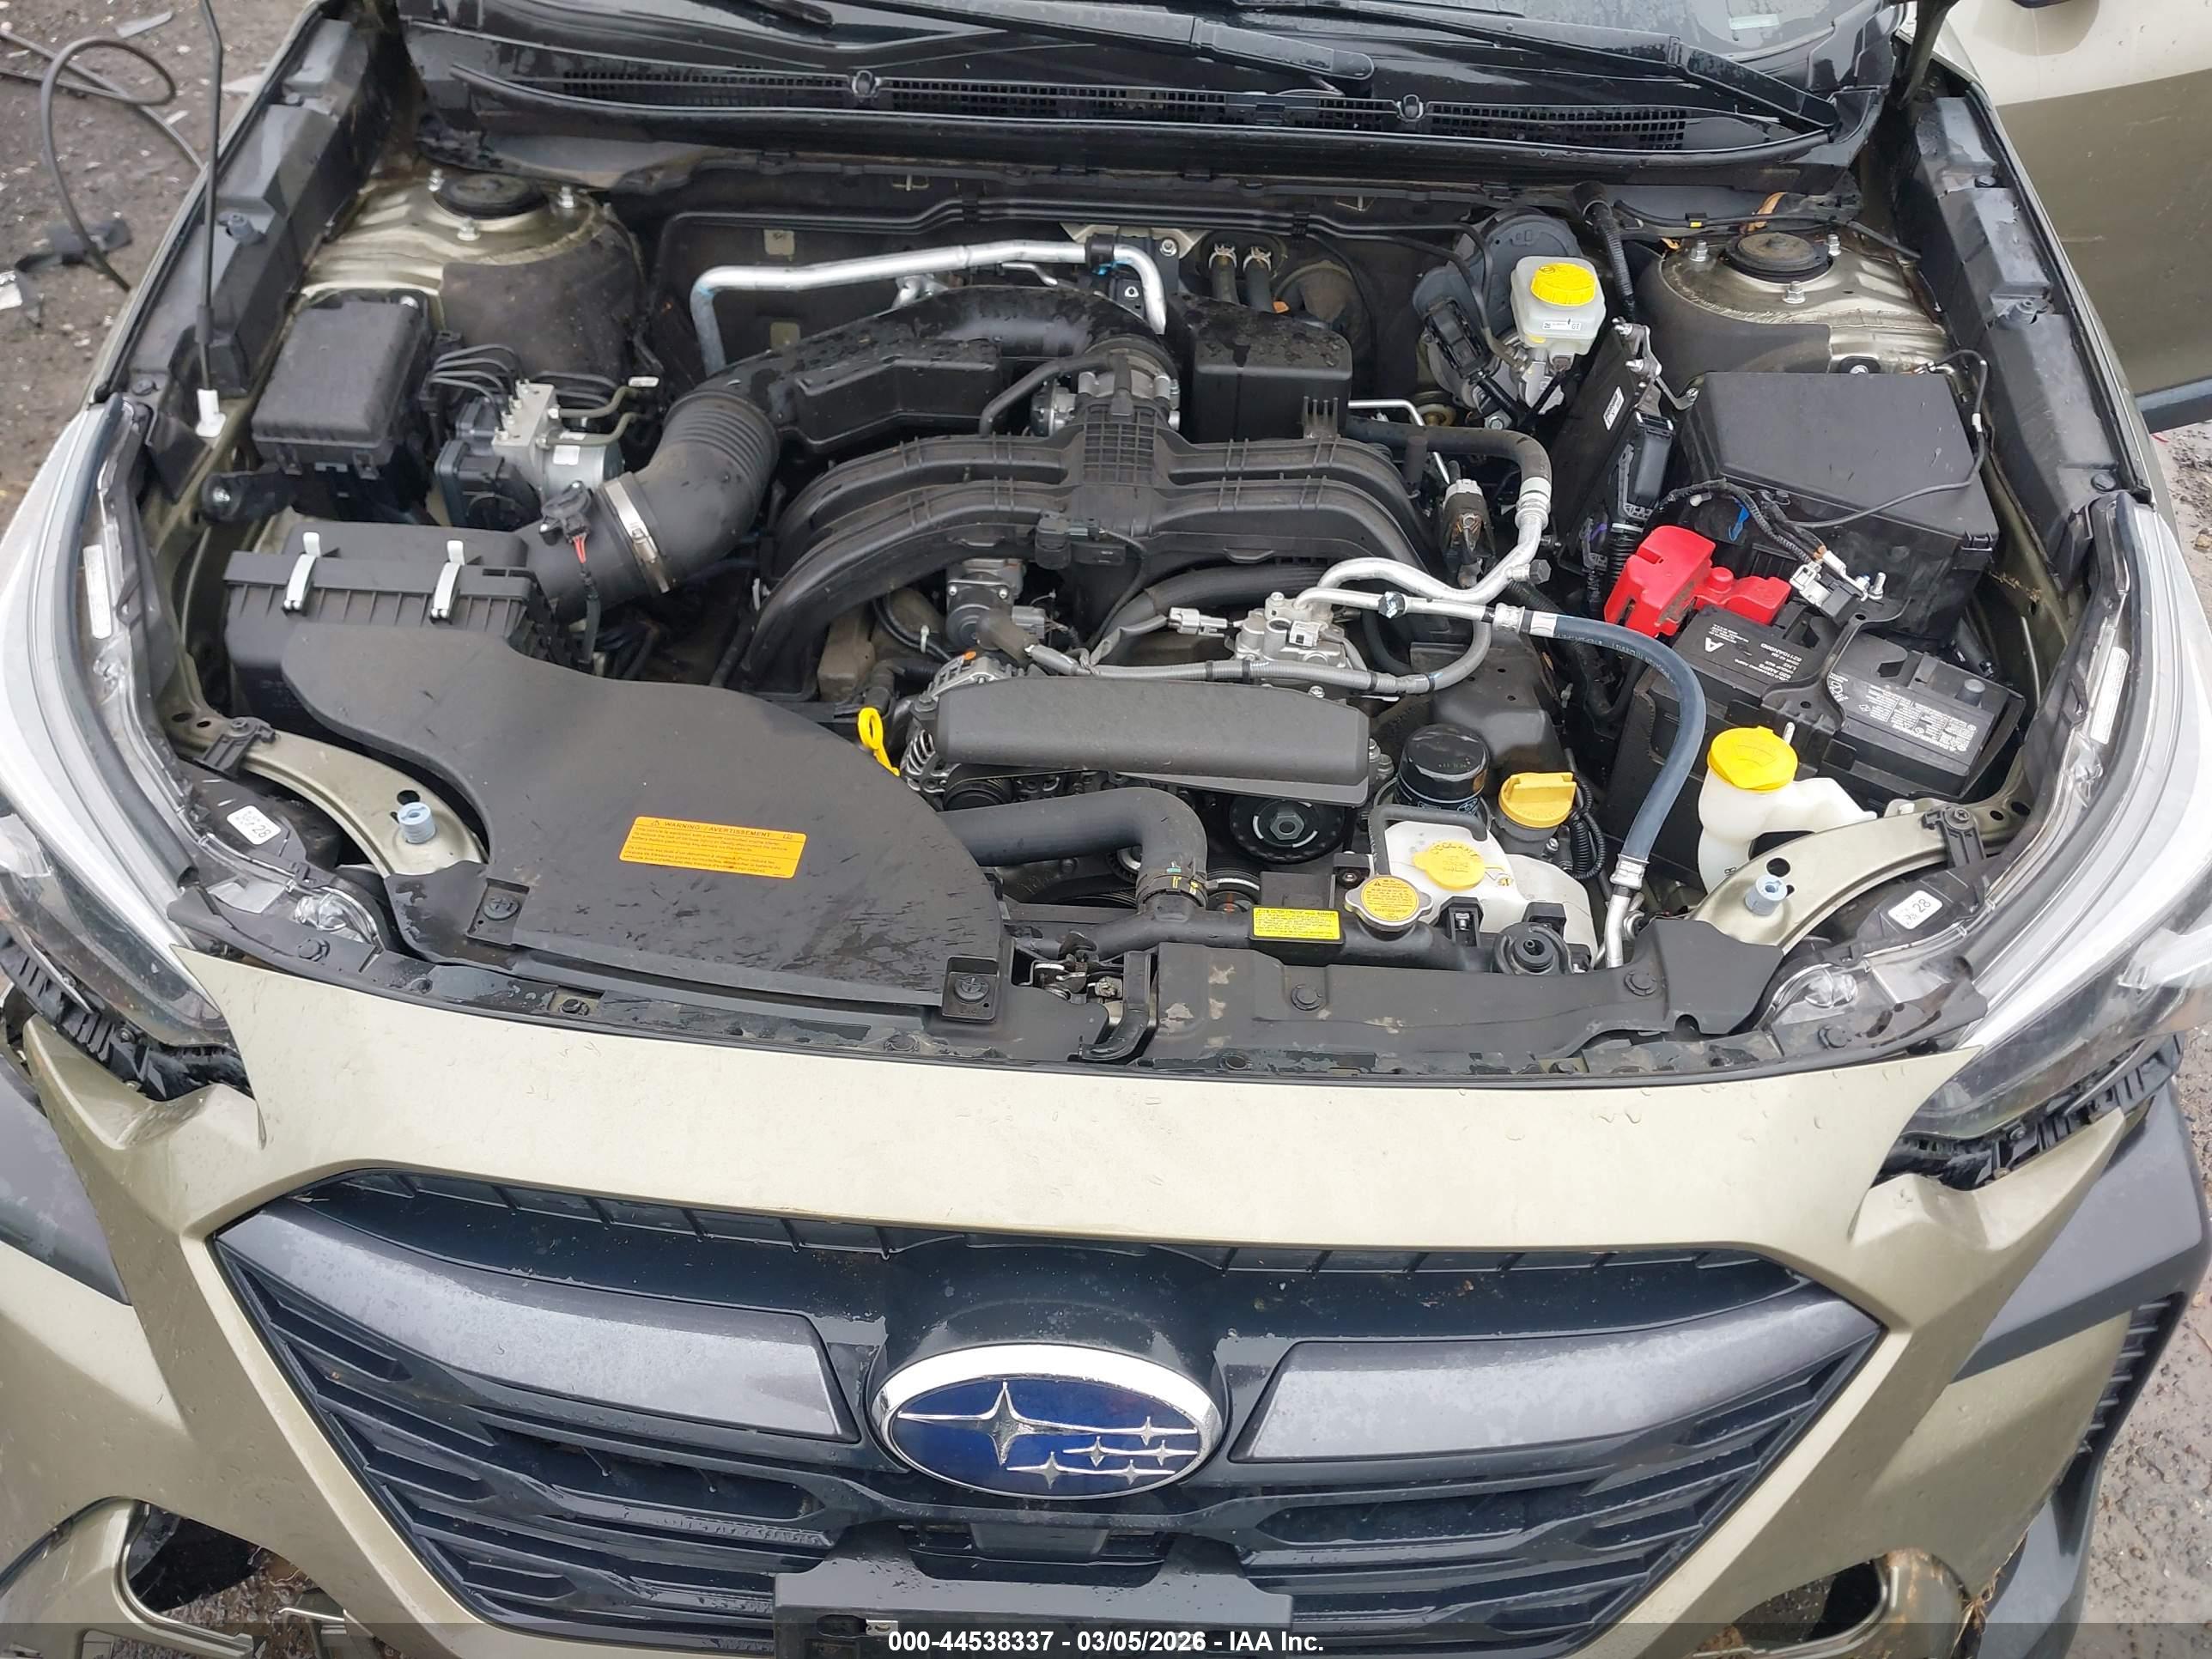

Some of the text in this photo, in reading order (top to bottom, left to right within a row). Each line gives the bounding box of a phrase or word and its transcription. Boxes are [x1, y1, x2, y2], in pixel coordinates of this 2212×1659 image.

[1759, 663, 1778, 673] AMPS
[252, 824, 271, 838] 28
[665, 821, 701, 830] WARNING
[708, 826, 771, 838] AVERTISSEMENT
[1912, 898, 1930, 913] 28
